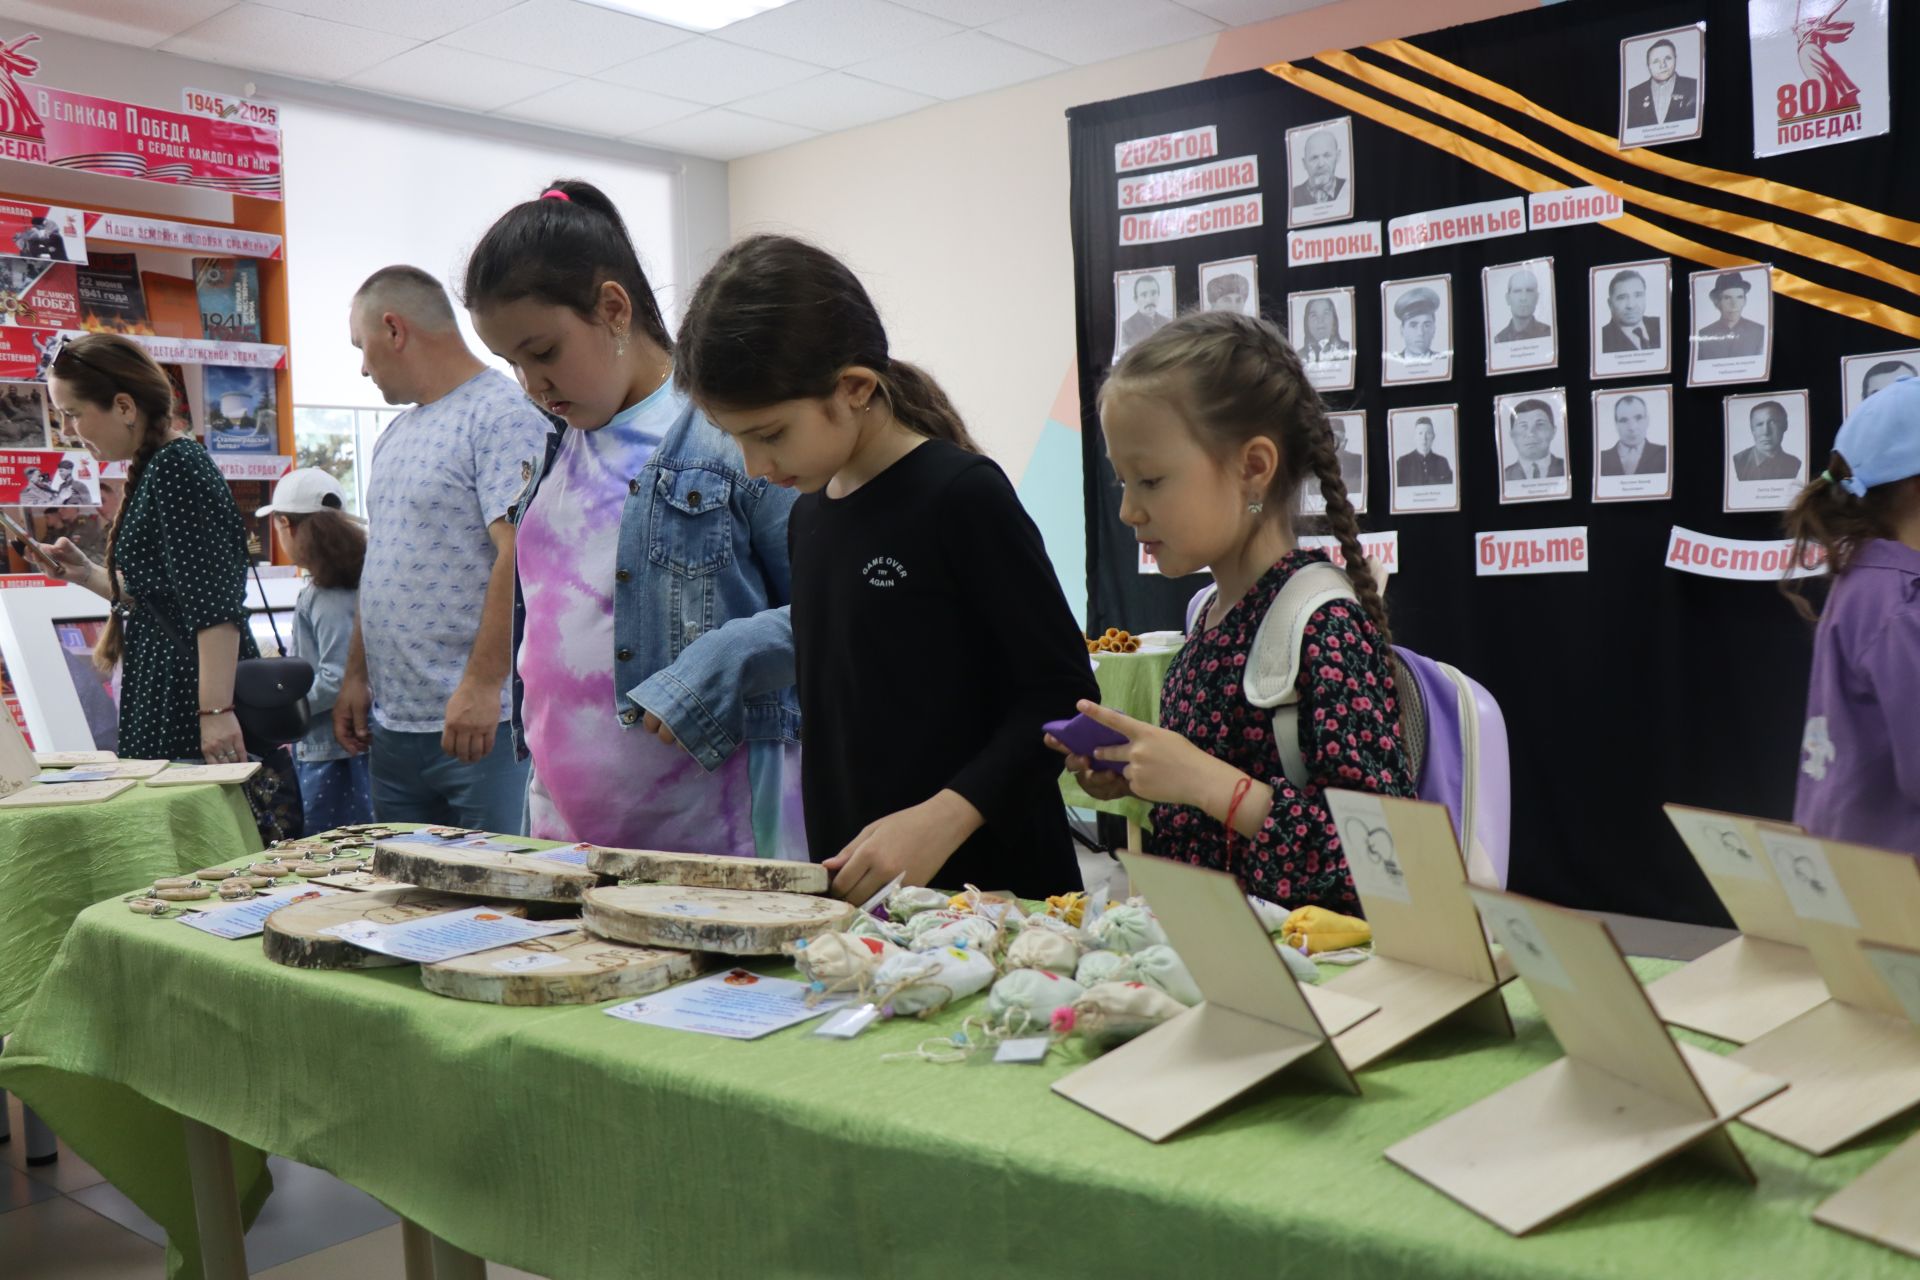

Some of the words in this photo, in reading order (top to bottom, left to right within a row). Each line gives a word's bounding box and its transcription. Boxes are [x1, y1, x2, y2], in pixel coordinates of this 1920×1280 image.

[186, 92, 223, 115] 1945
[239, 101, 276, 125] 2025
[1776, 79, 1820, 119] 80
[1777, 112, 1862, 145] ПОБЕДА!
[148, 141, 185, 158] СЕРДЦЕ
[189, 147, 233, 166] КАЖДОГО
[238, 155, 249, 168] ИЗ
[253, 157, 270, 172] НАС
[1292, 231, 1379, 262] Строки,
[1393, 208, 1521, 247] опаленные
[1533, 193, 1619, 224] войной
[31, 296, 77, 313] ПОБЕД
[104, 290, 129, 303] года
[202, 312, 242, 331] 1941
[863, 557, 884, 575] GAME
[886, 557, 907, 578] OVER
[1480, 535, 1585, 571] будьте
[869, 578, 894, 587] AGAIN
